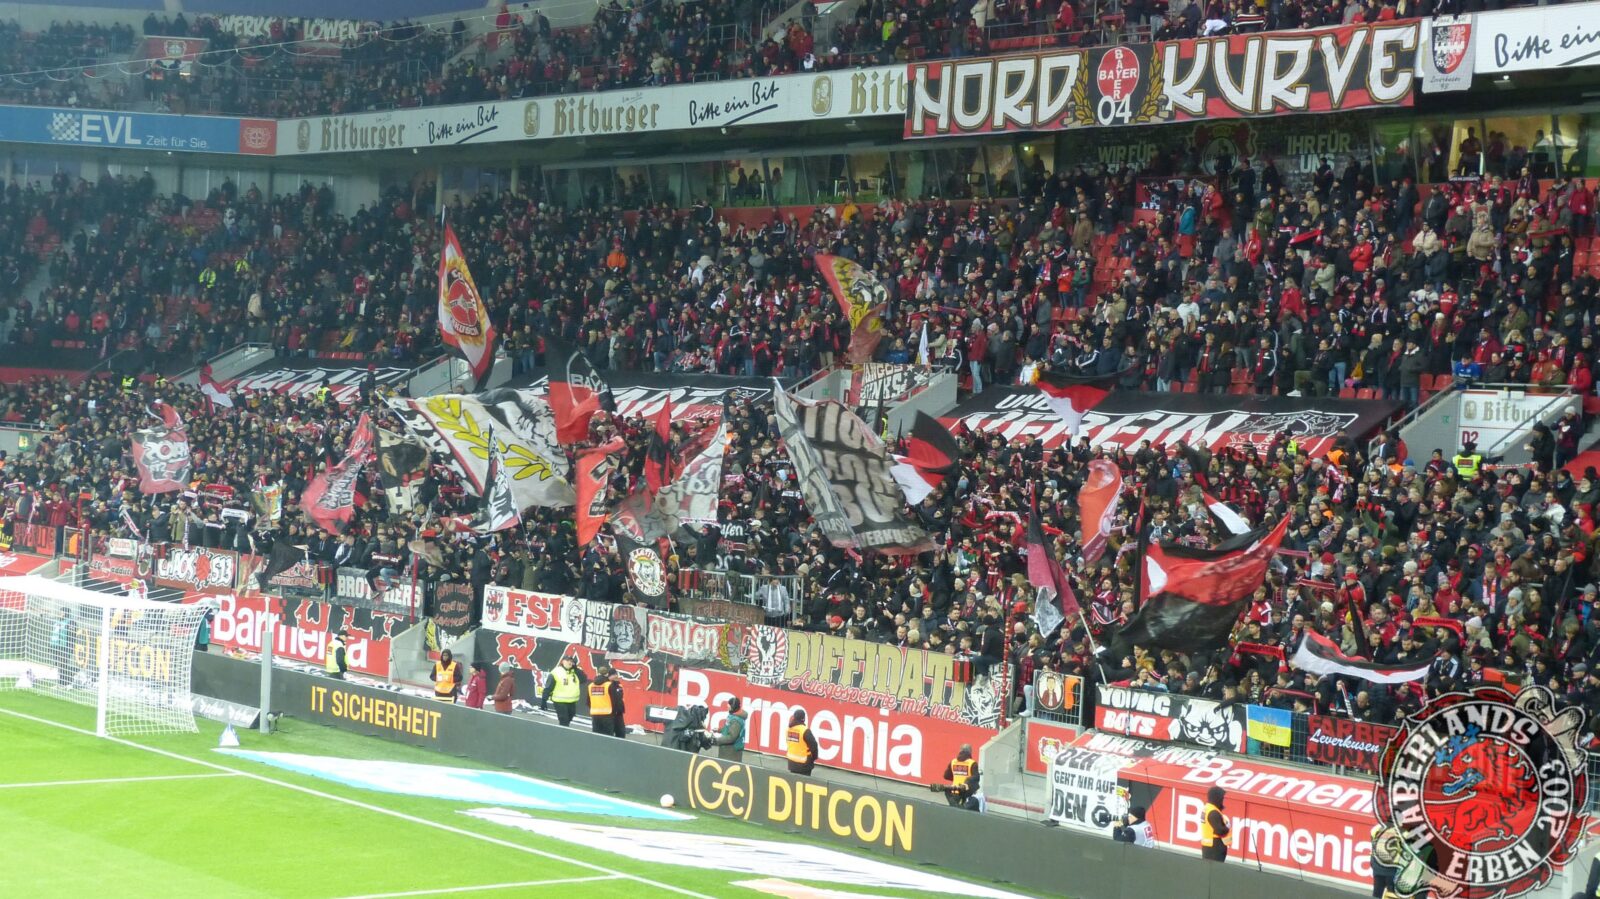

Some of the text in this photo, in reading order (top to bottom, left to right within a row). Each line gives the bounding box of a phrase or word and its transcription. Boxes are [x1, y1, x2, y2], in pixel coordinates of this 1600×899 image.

[1494, 33, 1553, 68] Bitte
[1099, 67, 1138, 80] BAYER
[1163, 22, 1418, 115] KURVE
[688, 80, 779, 126] Bitte ein Bit
[911, 52, 1082, 134] NORD
[1098, 93, 1132, 126] 04
[80, 114, 142, 146] EVL
[146, 136, 169, 147] Zeit
[171, 135, 186, 148] für
[428, 105, 498, 145] Bitte ein Bit
[553, 95, 661, 135] Bitburger
[321, 117, 406, 151] Bitburger
[1287, 129, 1351, 155] IHR FÜR
[505, 591, 565, 631] FSI
[585, 616, 611, 636] SIDE
[586, 600, 613, 620] WEST
[584, 632, 610, 651] BOYZ
[311, 686, 442, 739] IT SICHERHEIT
[901, 695, 929, 716] mit
[1099, 687, 1171, 717] YOUNG
[1103, 709, 1157, 737] BOYS
[1309, 728, 1380, 752] Leverkusen
[1054, 770, 1076, 786] GEHT
[1095, 779, 1116, 795] AUF
[767, 775, 914, 851] DITCON
[1053, 788, 1088, 823] DEN
[1177, 795, 1373, 878] Brmenia
